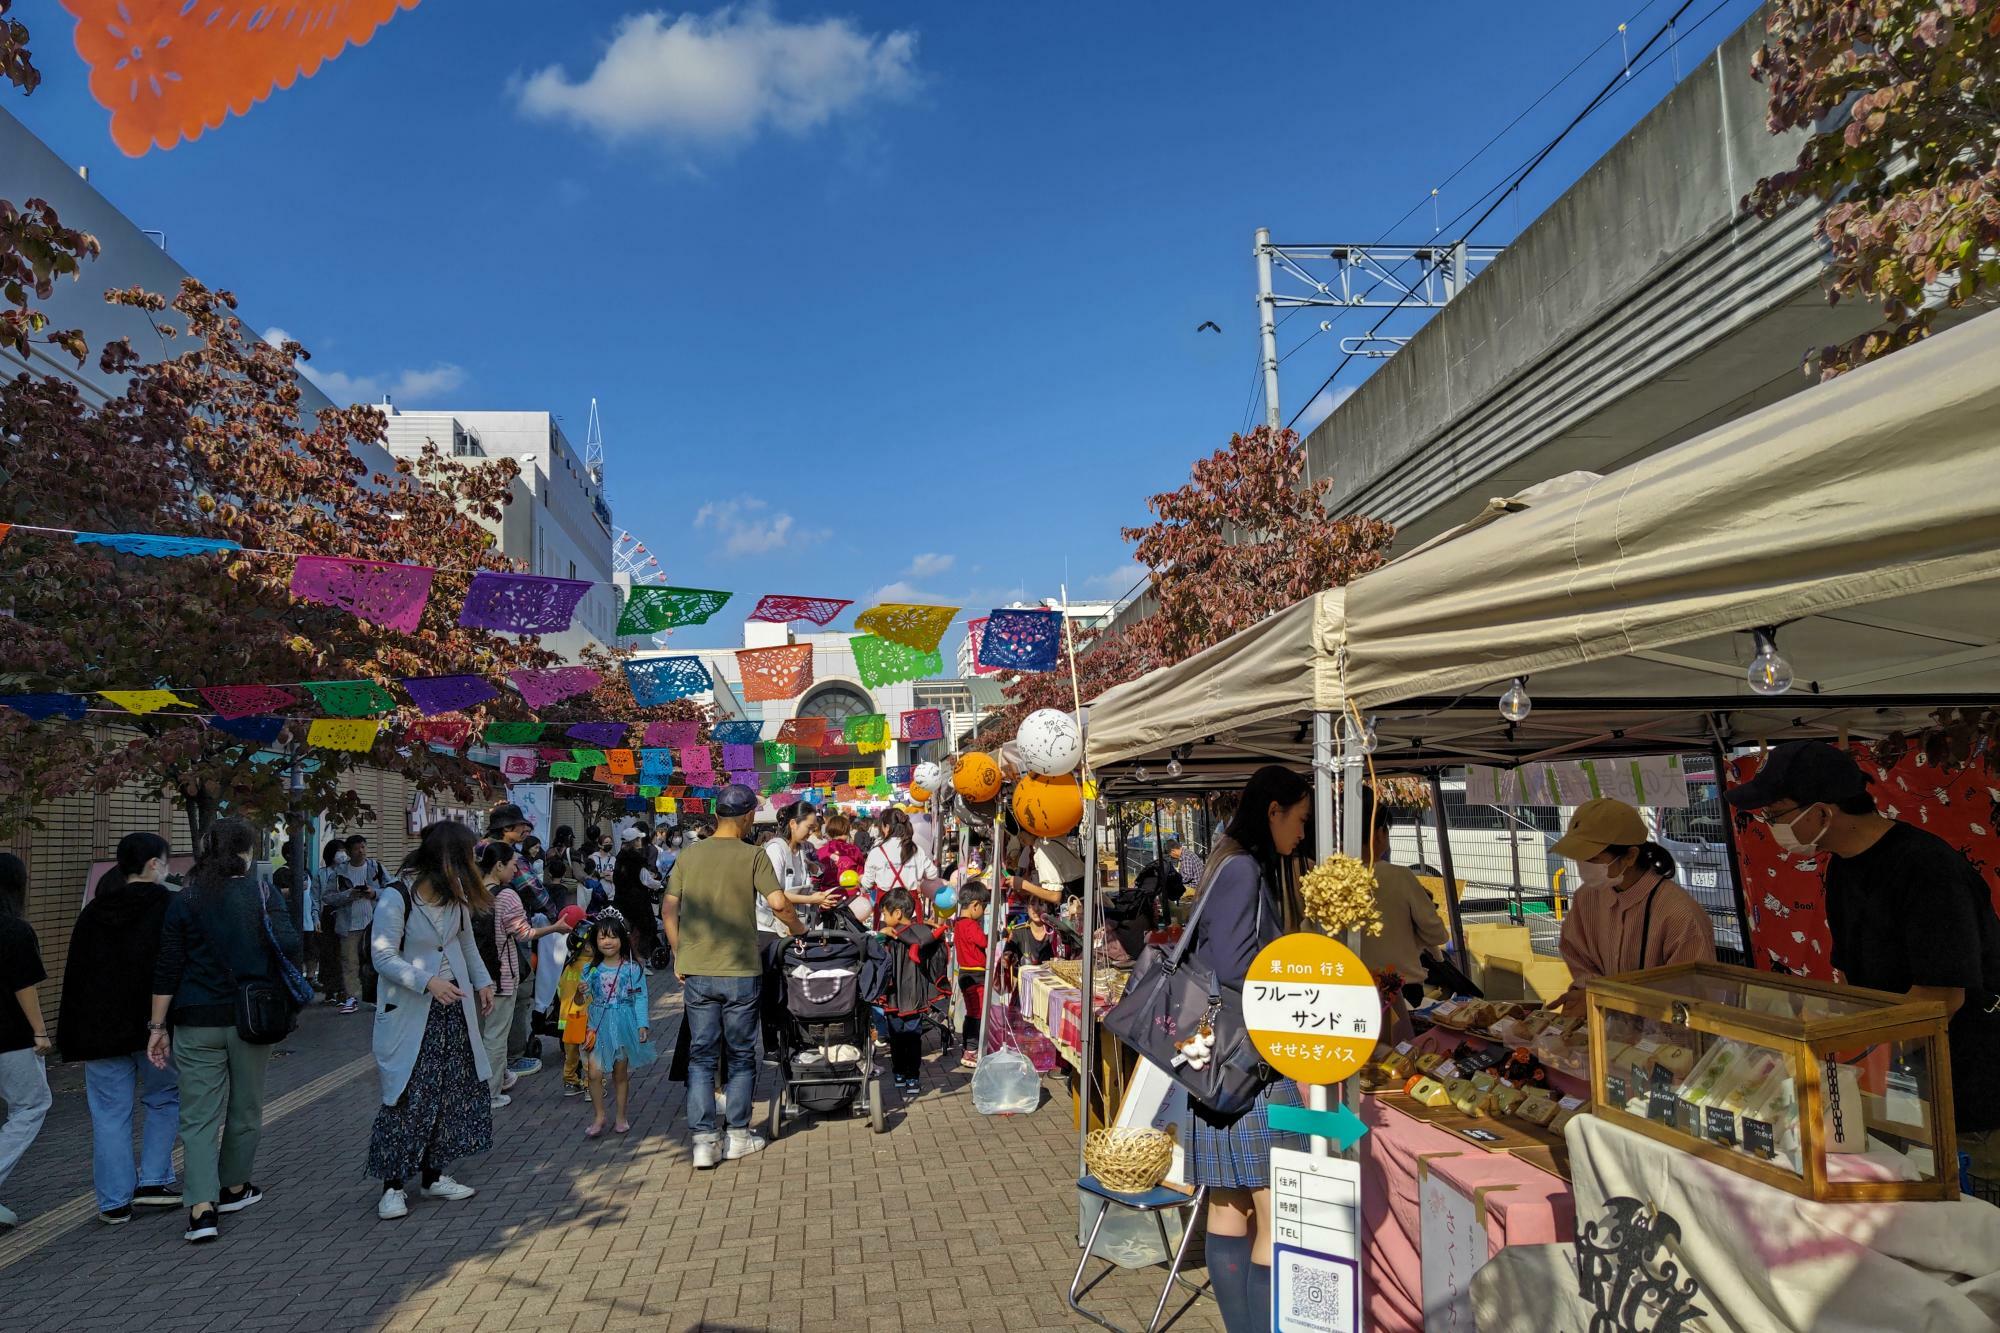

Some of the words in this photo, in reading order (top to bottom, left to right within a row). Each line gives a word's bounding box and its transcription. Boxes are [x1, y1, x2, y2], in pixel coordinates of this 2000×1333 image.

[1271, 960, 1282, 974] 果
[1287, 964, 1312, 975] non
[1320, 962, 1345, 977] 行き
[1254, 986, 1320, 1005] フルーツ
[1292, 1010, 1342, 1031] サンド
[1353, 1018, 1367, 1033] 前
[1269, 1042, 1356, 1063] せせらぎバス
[1279, 1176, 1298, 1188] 住所
[1279, 1201, 1298, 1214] 時間
[1279, 1226, 1299, 1240] TEL
